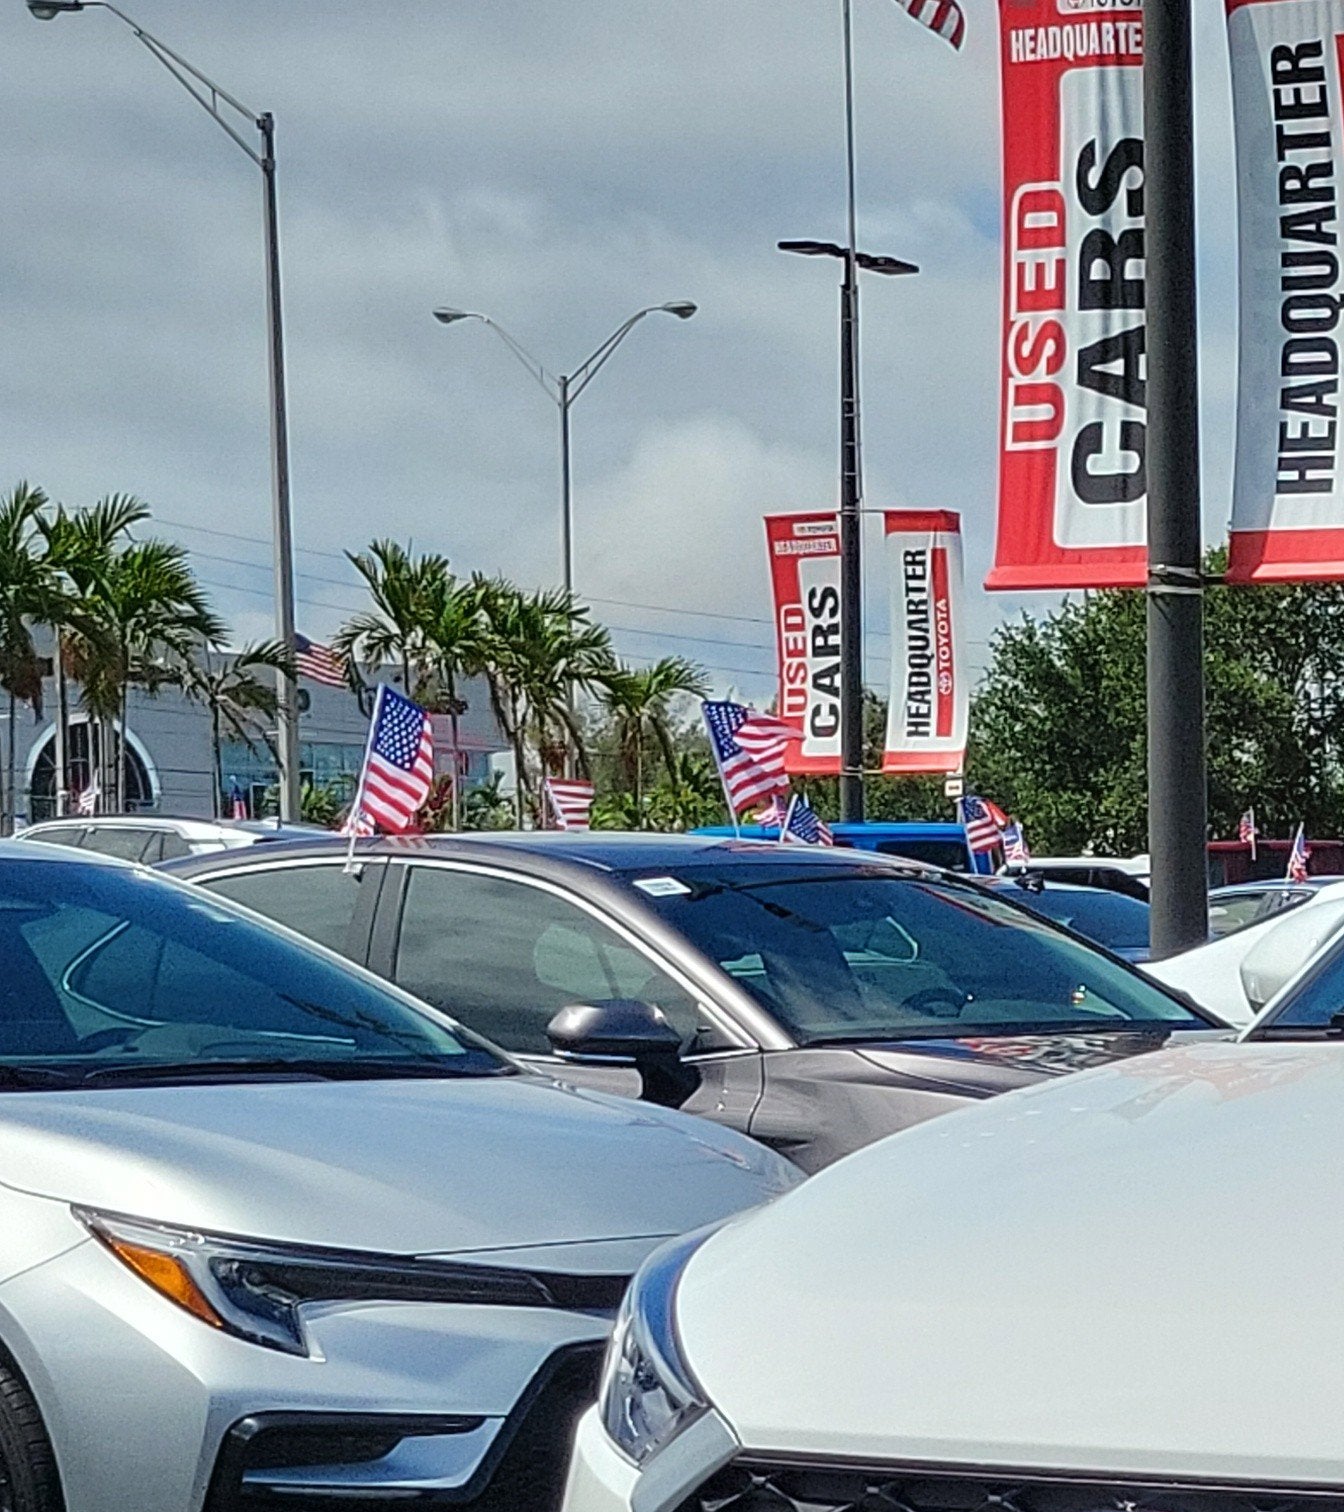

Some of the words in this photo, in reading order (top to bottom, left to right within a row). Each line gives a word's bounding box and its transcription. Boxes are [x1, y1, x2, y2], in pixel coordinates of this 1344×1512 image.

[1010, 21, 1143, 63] HEADQUARTE
[1011, 185, 1066, 445] USED
[1071, 138, 1147, 506] CARS
[780, 606, 808, 716] USED
[807, 585, 841, 738] CARS
[904, 549, 935, 738] HEADQUARTER
[936, 599, 951, 672] TOYOTA
